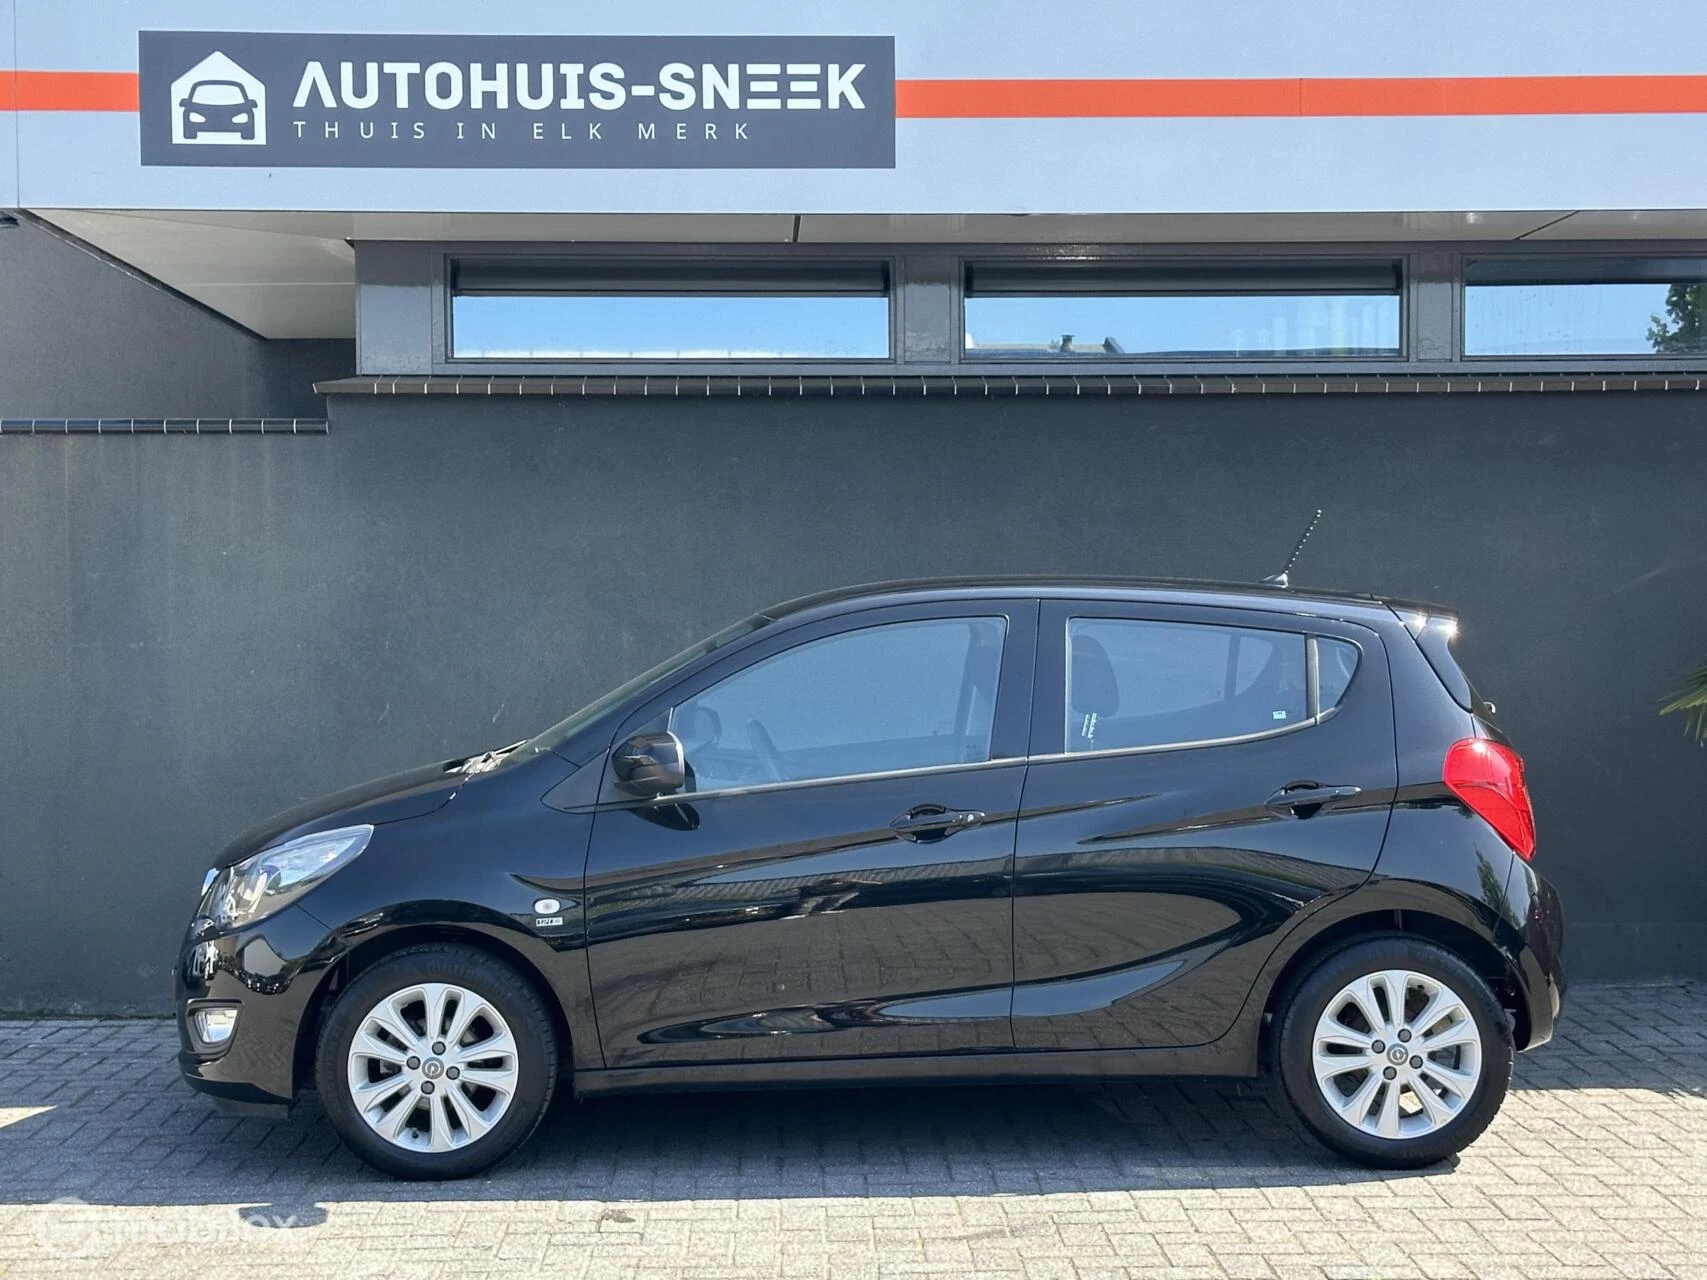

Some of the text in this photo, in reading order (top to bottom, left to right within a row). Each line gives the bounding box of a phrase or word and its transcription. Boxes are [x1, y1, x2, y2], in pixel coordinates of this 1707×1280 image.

[292, 61, 866, 111] AUTOHUIS-SNEEK
[293, 121, 748, 140] THUIS IN ELK MERK
